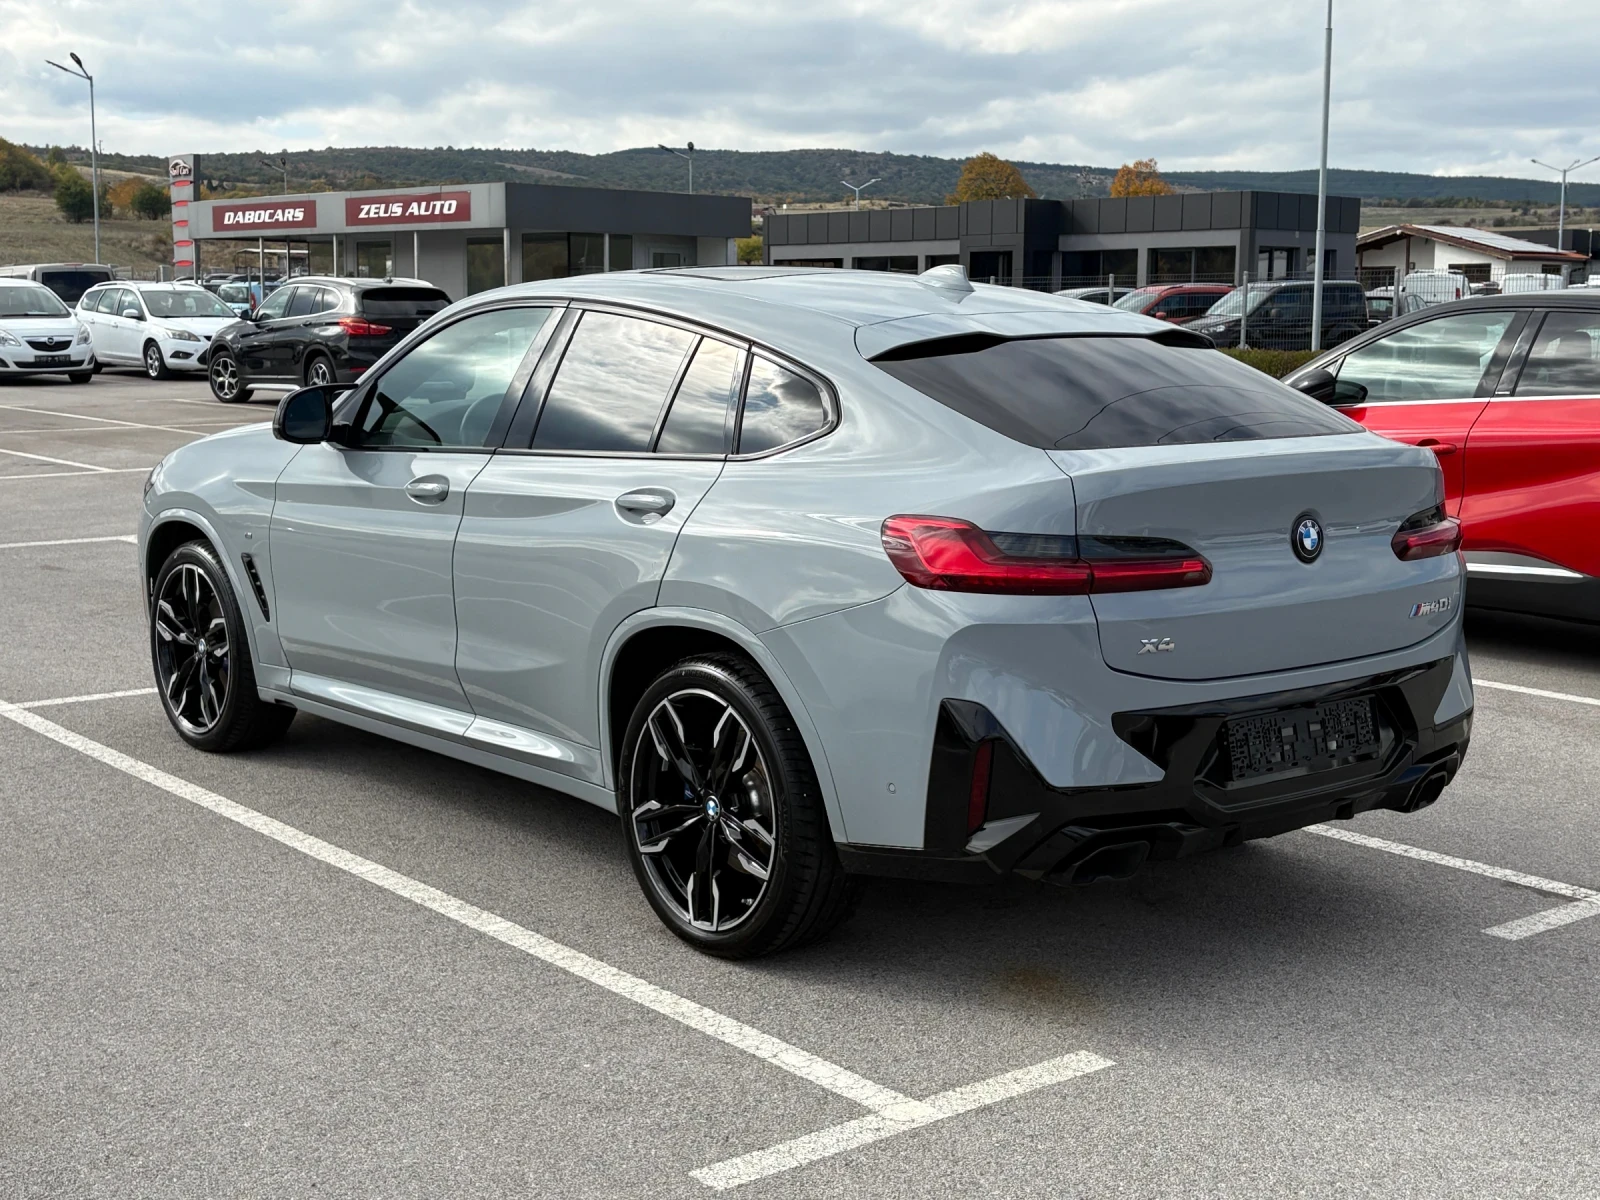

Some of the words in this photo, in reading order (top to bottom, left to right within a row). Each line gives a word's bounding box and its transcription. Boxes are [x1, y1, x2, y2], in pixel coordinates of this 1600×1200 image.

[224, 208, 304, 224] DABOCARS
[358, 202, 403, 218] ZEUS
[405, 200, 457, 216] AUTO
[1137, 637, 1175, 654] X4
